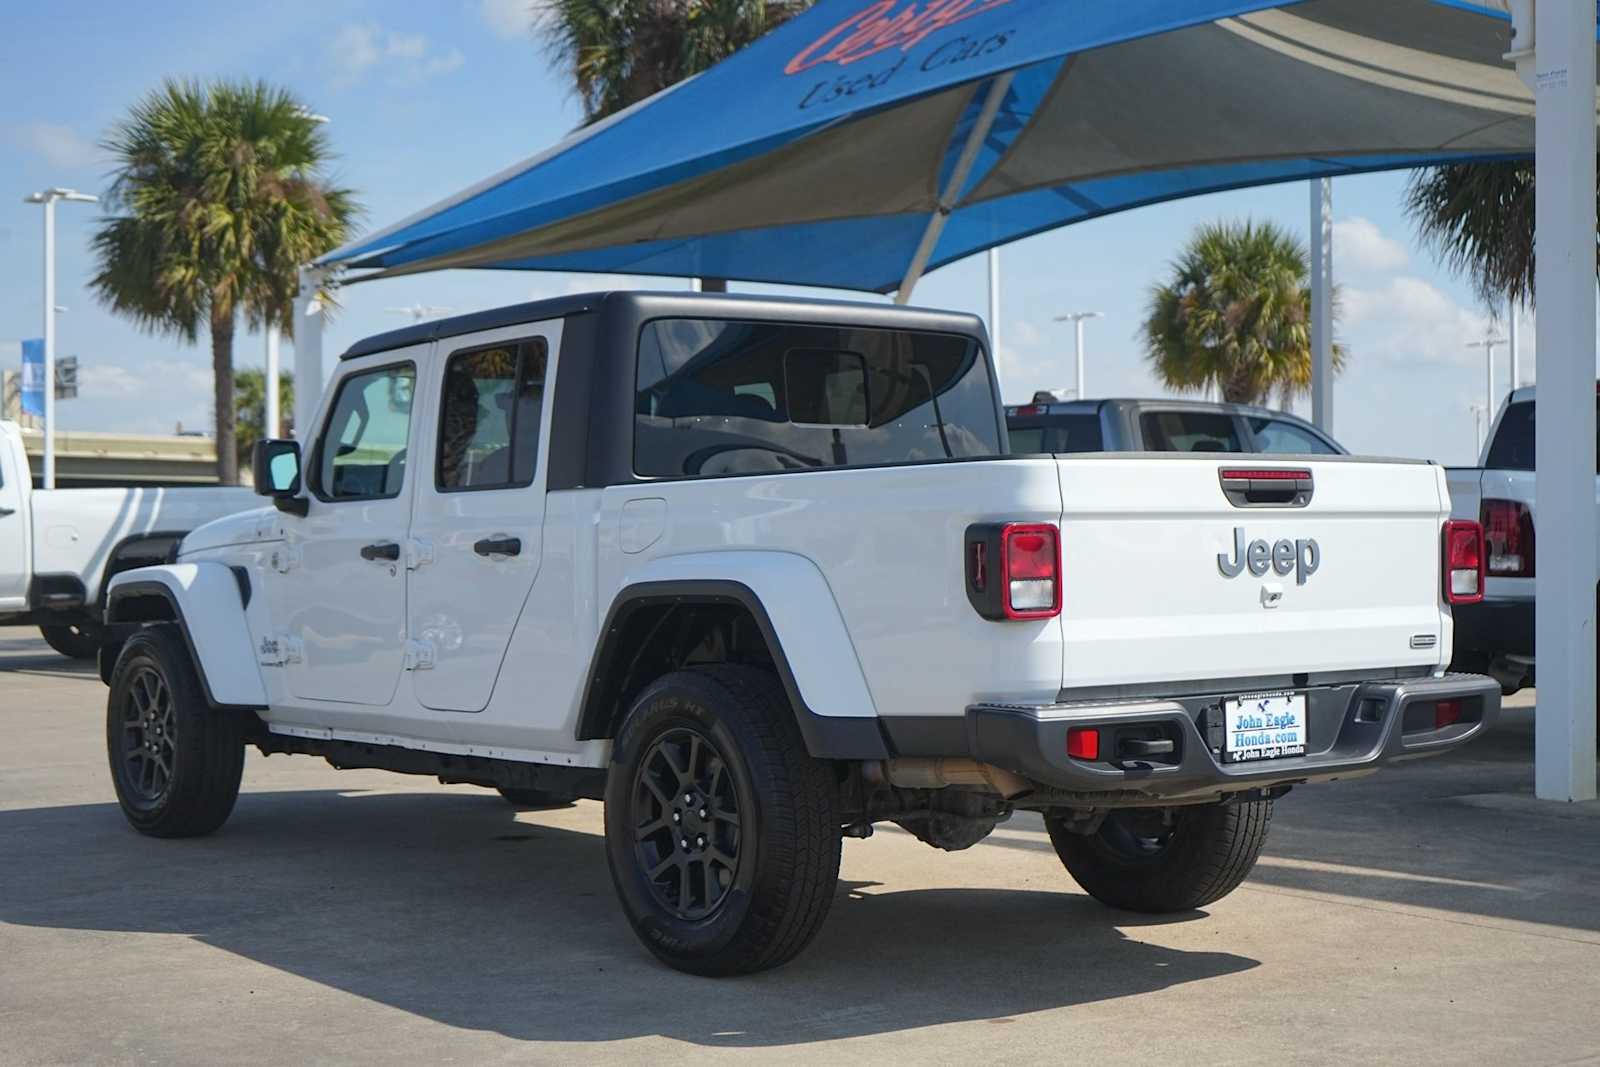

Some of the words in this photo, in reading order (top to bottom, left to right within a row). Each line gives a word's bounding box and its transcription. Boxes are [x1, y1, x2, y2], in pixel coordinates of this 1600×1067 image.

[798, 56, 908, 109] Used
[920, 30, 1016, 72] Cars
[1217, 527, 1320, 586] Jeep
[1236, 714, 1263, 730] John
[1265, 711, 1296, 729] Eagle
[1234, 731, 1298, 747] Honda.com
[1242, 749, 1260, 760] John
[1261, 747, 1281, 758] Eagle
[1281, 745, 1304, 756] Honda
